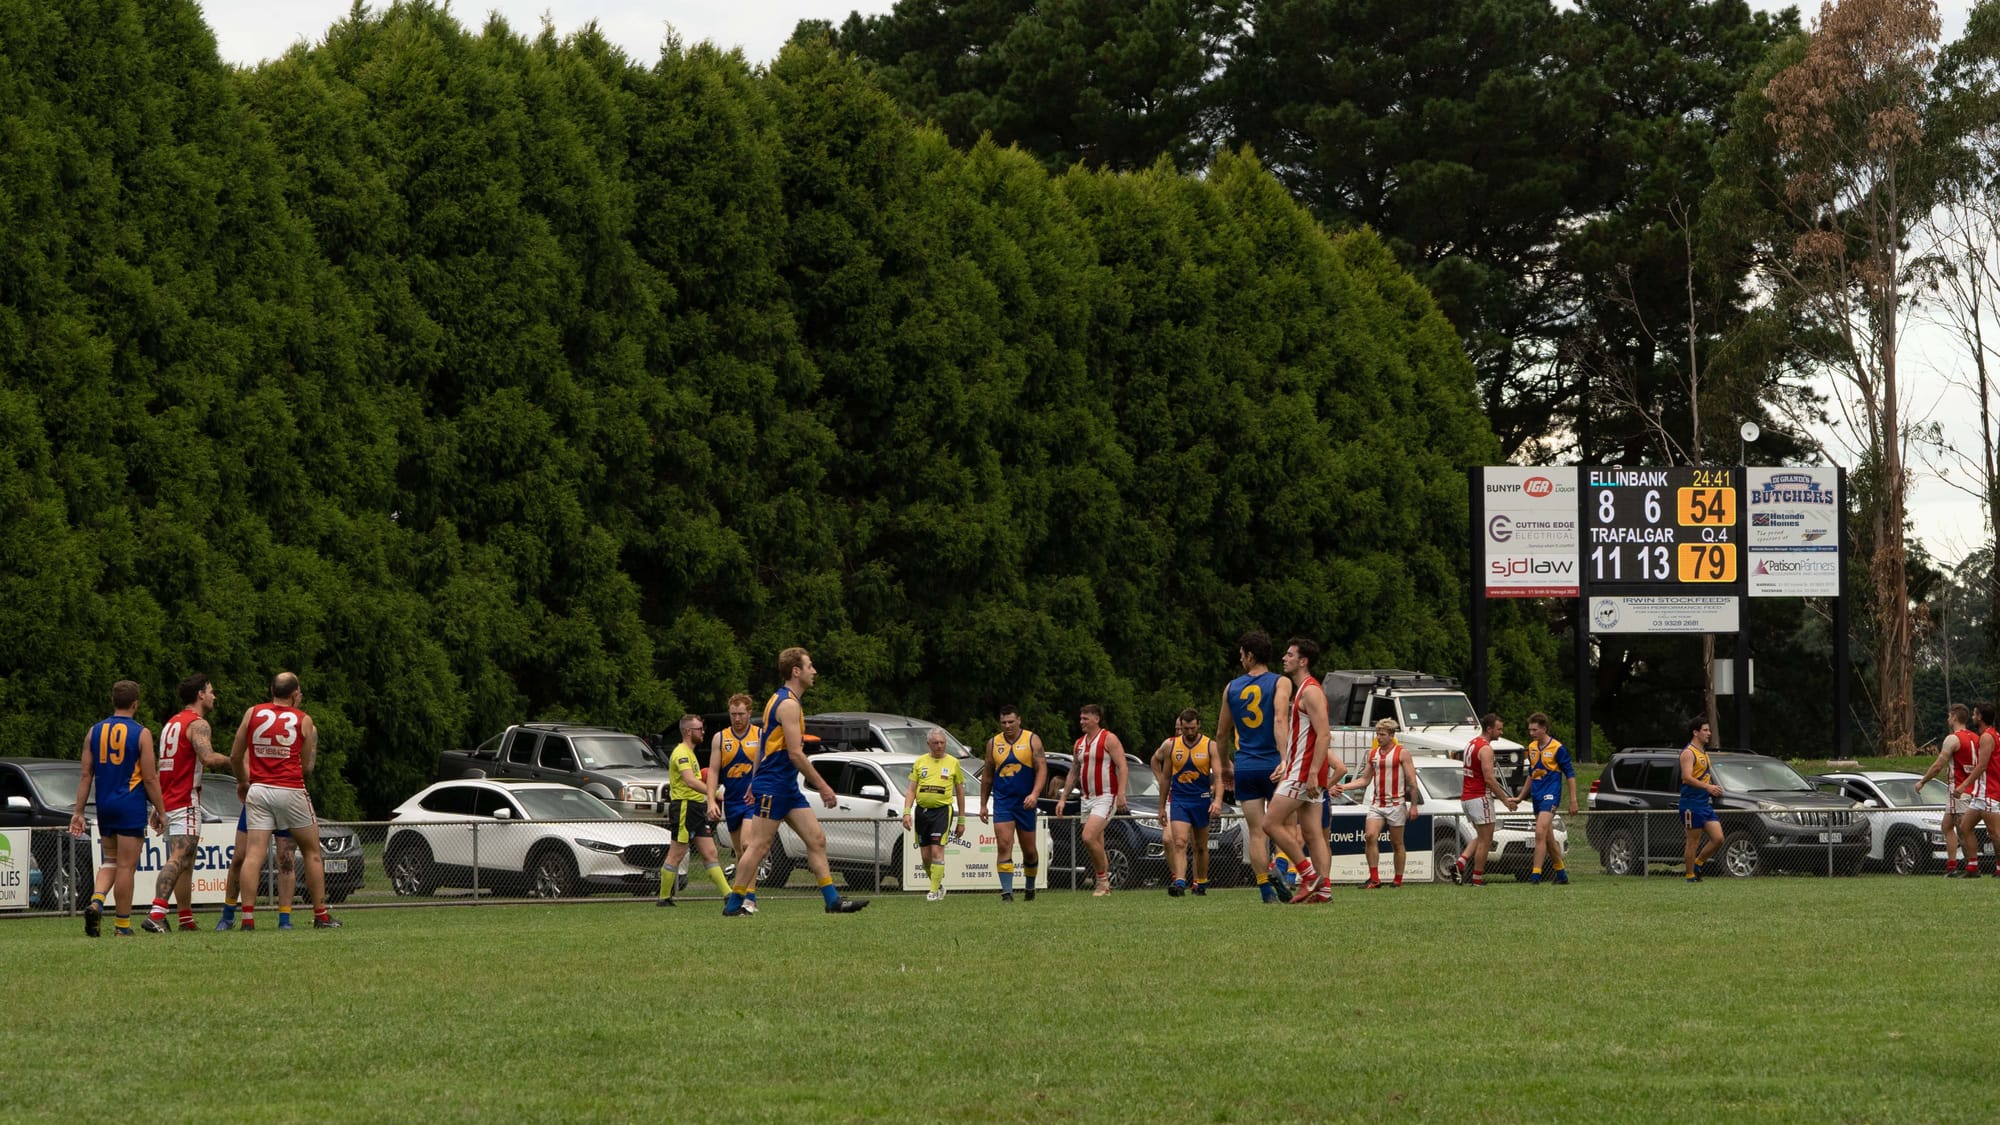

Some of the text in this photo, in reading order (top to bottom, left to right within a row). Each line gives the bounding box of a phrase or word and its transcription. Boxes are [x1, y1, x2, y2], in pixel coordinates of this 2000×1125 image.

[1590, 470, 1730, 487] ELLINBANK 24:41
[1486, 484, 1521, 493] BUNYIP
[1526, 480, 1550, 494] IGA
[1751, 490, 1834, 505] BUTCHERS
[1598, 489, 1726, 524] 8 6 54
[1515, 521, 1575, 529] CUTTING EDGE
[1515, 532, 1575, 540] ELECTRICAL
[1590, 527, 1728, 543] TRAFALGAR Q.4
[1591, 545, 1725, 580] 11 13 79
[1240, 684, 1264, 729] 3
[252, 709, 298, 746] 23
[99, 722, 128, 766] 19
[946, 836, 972, 849] PREAD
[1329, 830, 1354, 843] rowe
[0, 870, 21, 887] LIES
[197, 878, 228, 892] Build
